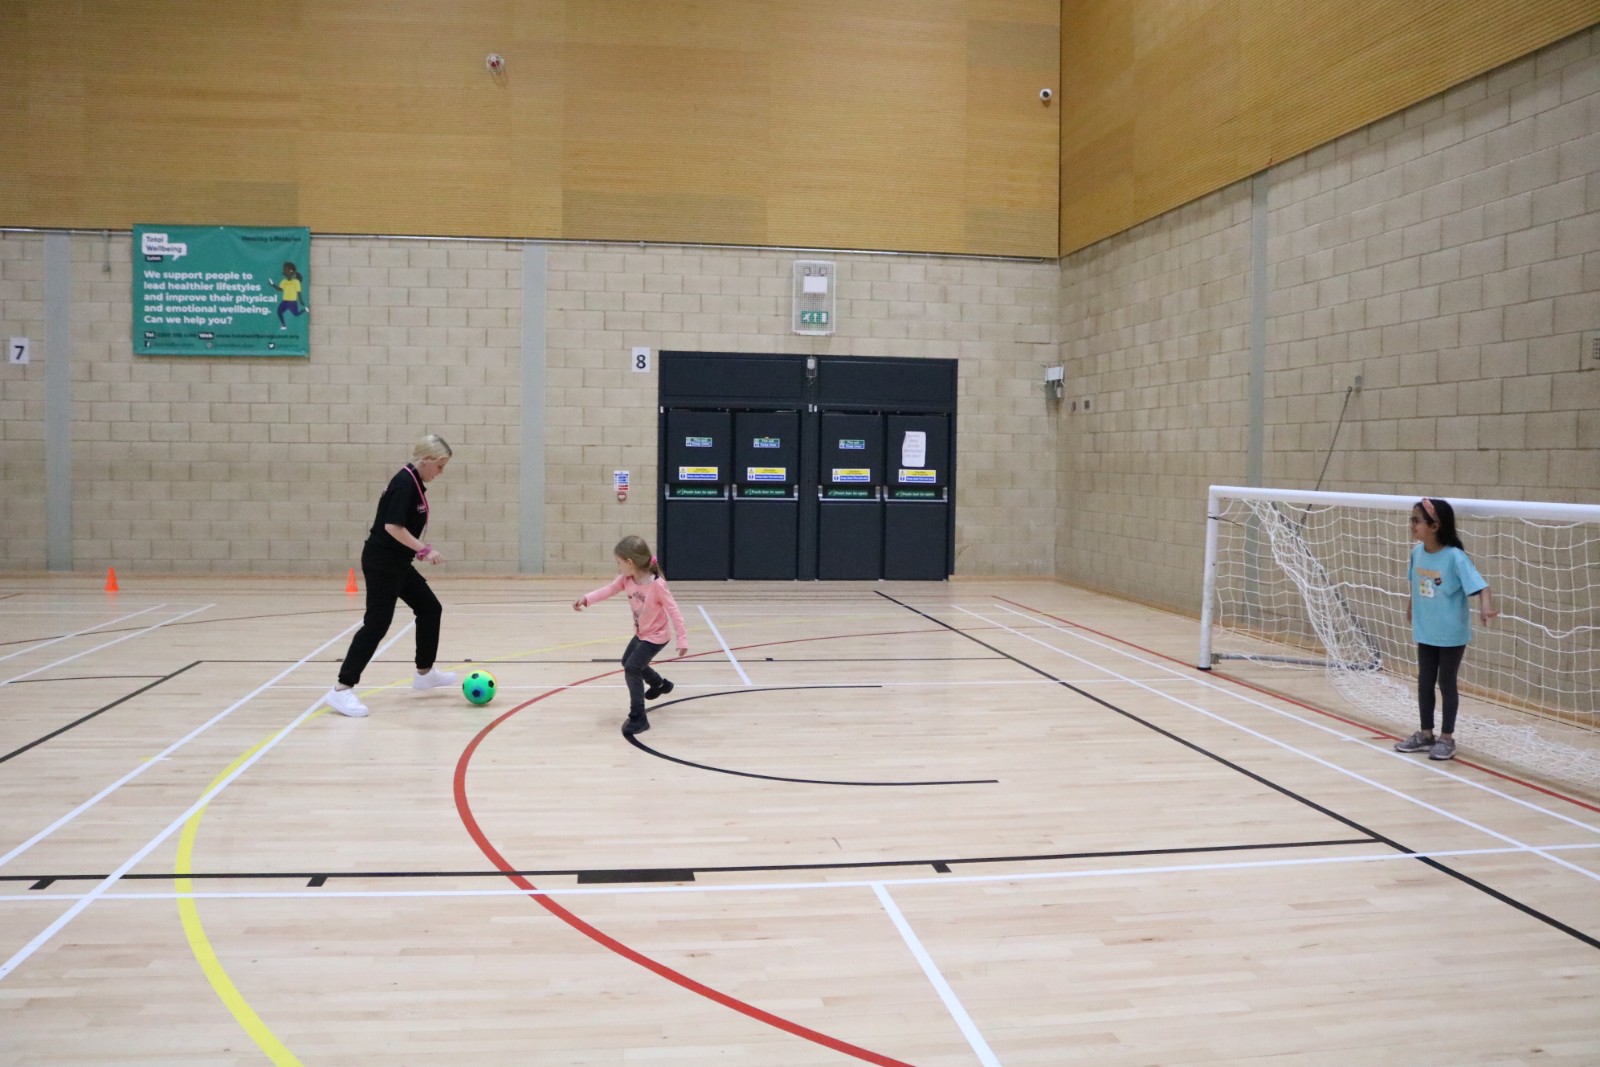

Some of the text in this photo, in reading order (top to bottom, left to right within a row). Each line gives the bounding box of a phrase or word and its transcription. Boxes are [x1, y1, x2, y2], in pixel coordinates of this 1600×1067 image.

[146, 245, 182, 253] Wellbeing
[143, 270, 253, 281] We support people to
[143, 281, 261, 292] lead healthier lifestyles
[143, 292, 278, 304] and improve their physical
[143, 304, 272, 316] and emotional wellbeing.
[143, 315, 233, 326] Can we help you?
[14, 345, 25, 360] 7
[636, 354, 647, 370] 8
